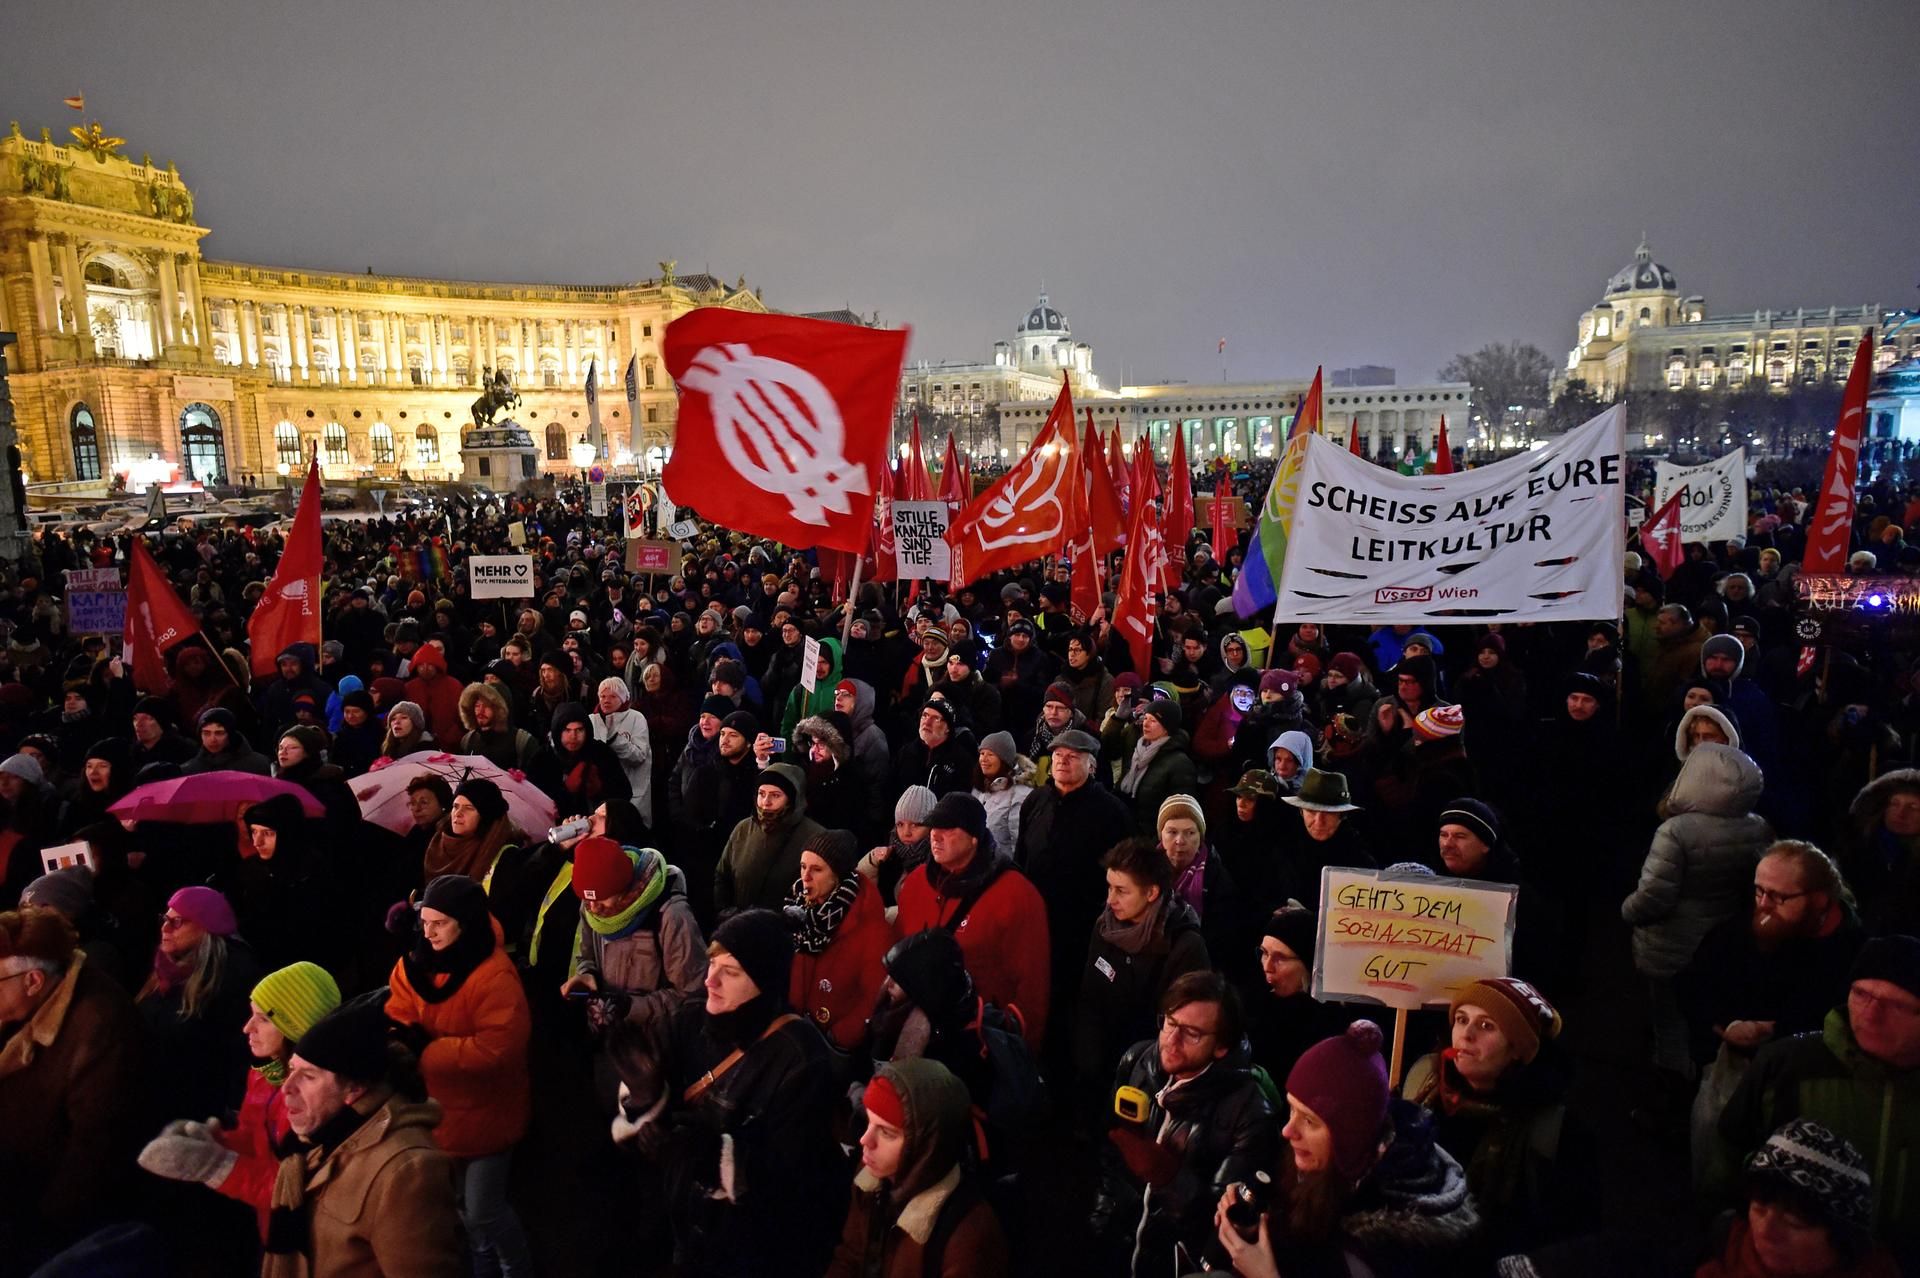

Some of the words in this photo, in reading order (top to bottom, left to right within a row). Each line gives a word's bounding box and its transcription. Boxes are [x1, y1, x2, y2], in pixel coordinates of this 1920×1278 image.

[1307, 481, 1437, 525] SCHEISS
[1445, 489, 1517, 523] AUF
[1527, 454, 1620, 499] EURE
[1680, 475, 1733, 533] DONNERSTAGSD
[896, 510, 938, 525] STILLE
[894, 523, 946, 539] KANZLER
[1351, 514, 1552, 562] LEITKULTUR
[902, 538, 932, 552] SIND
[901, 551, 932, 566] TIEF.
[474, 565, 511, 577] MEHR
[1438, 587, 1479, 599] Wien
[1337, 884, 1405, 912] GEHT'S
[1412, 896, 1462, 925] DEM
[1334, 917, 1496, 955] SOZIALSTAAT
[1364, 955, 1428, 981] GUT
